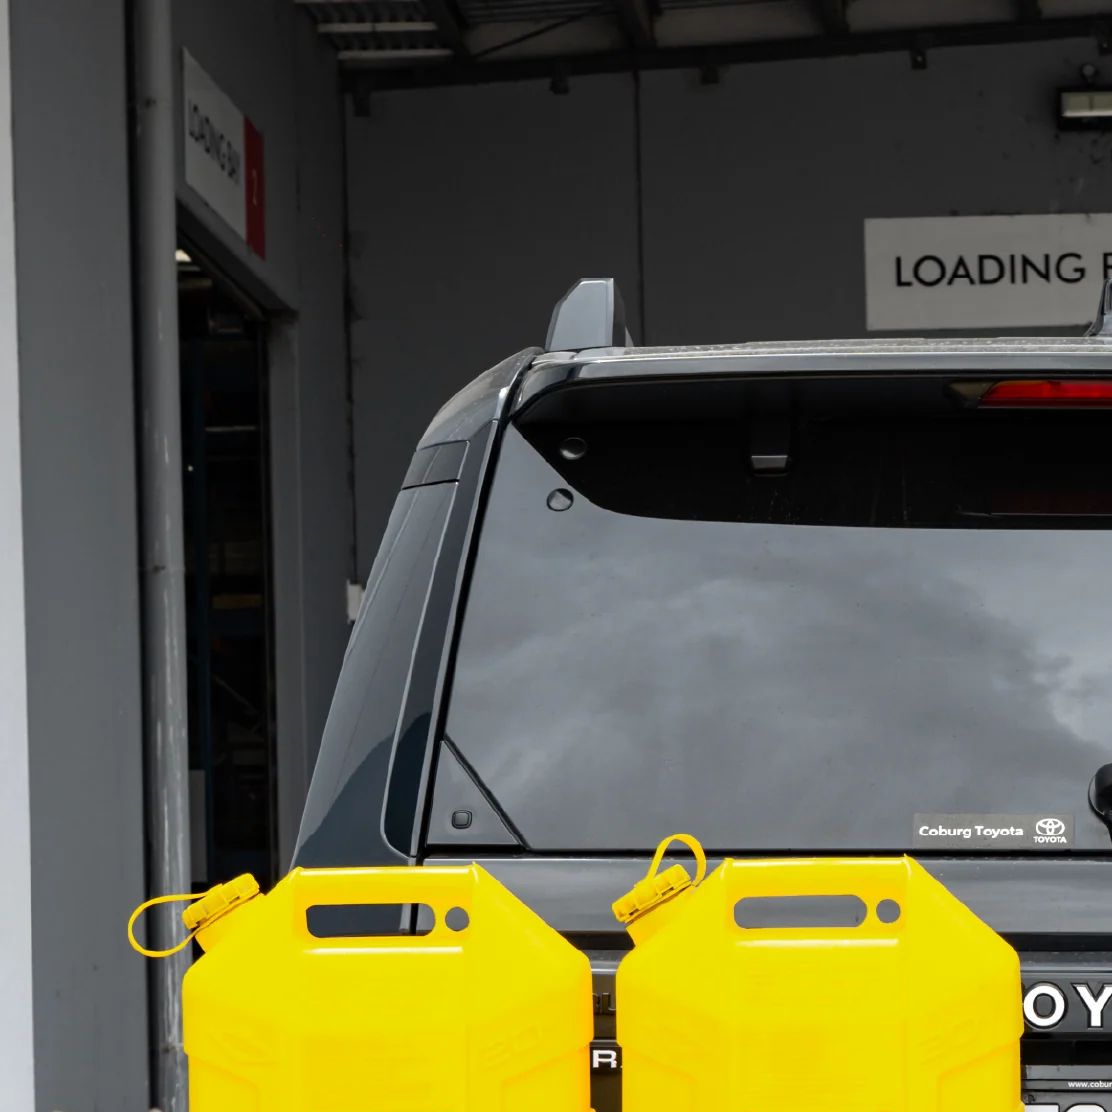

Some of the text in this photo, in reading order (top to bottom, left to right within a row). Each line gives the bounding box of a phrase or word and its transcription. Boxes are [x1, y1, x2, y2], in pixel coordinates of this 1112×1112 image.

[896, 252, 1086, 287] LOADING
[918, 825, 1024, 838] Coburg Toyota
